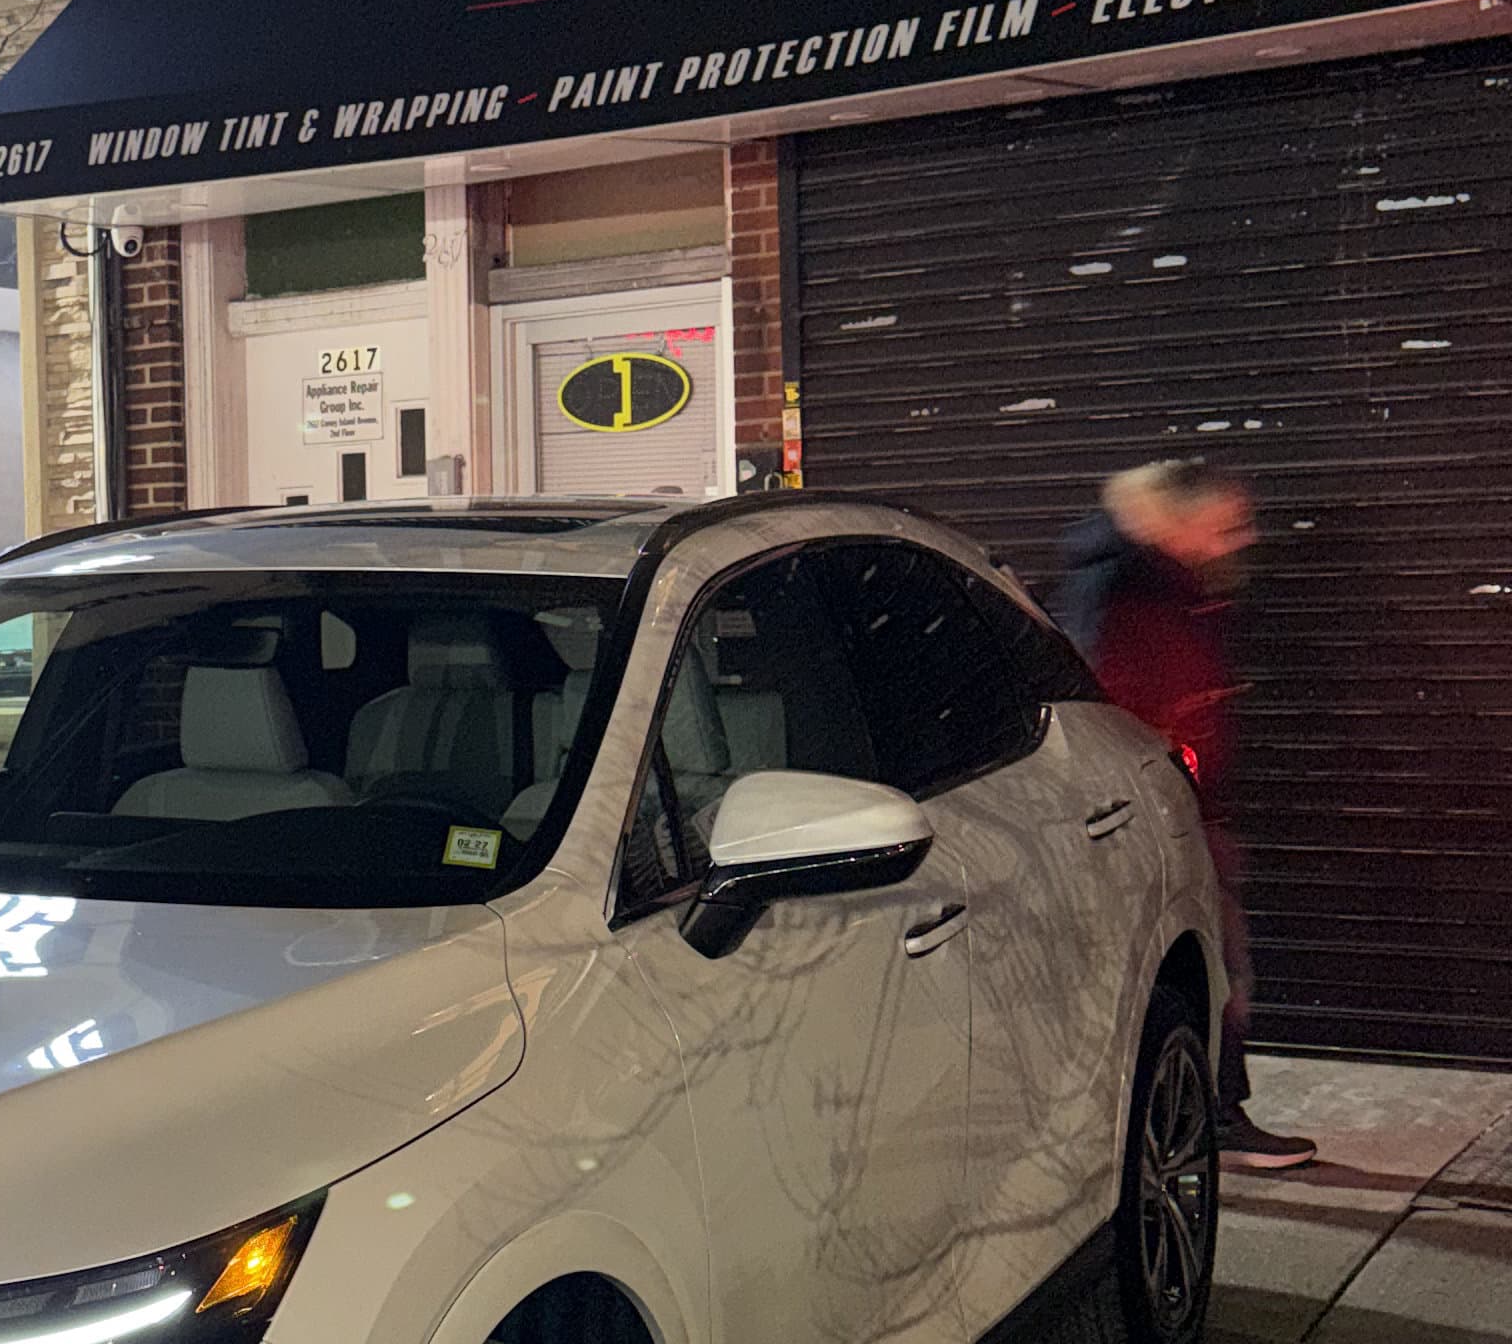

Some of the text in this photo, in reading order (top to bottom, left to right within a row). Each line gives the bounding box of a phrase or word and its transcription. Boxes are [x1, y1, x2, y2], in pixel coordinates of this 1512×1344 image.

[88, 121, 208, 167] WINDOW
[219, 111, 289, 152] TINT
[298, 110, 317, 143] &
[333, 84, 510, 139] WRAPPING
[548, 61, 663, 112] PAINT
[673, 18, 920, 94] PROTECTION
[321, 347, 378, 374] 2617
[306, 379, 379, 399] Appliance Repair
[319, 400, 346, 414] Group
